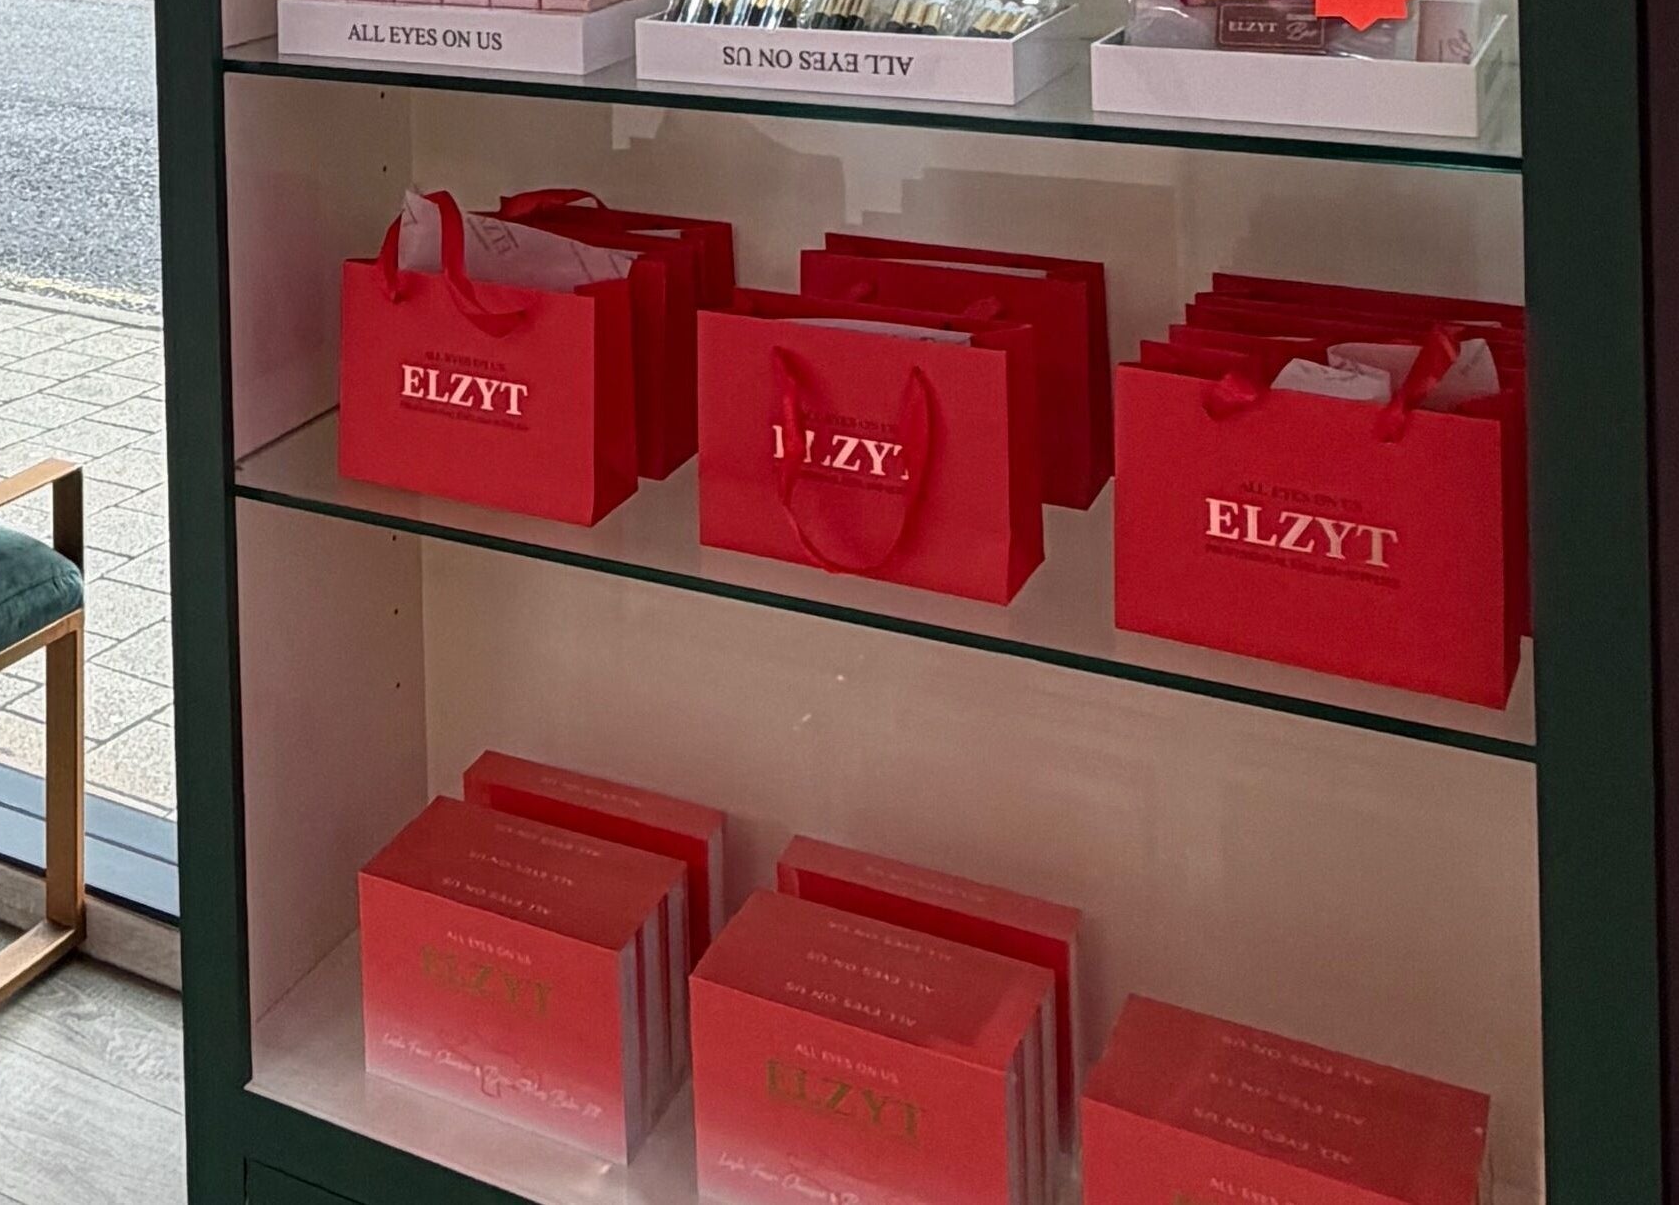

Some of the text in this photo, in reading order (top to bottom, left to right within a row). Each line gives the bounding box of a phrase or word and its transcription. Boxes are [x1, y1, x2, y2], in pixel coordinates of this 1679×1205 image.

[347, 23, 503, 52] ALL EYES ON US
[722, 45, 915, 77] ALL EYES ON US
[401, 364, 529, 416] ELZYT
[1205, 497, 1399, 568] ELZYT
